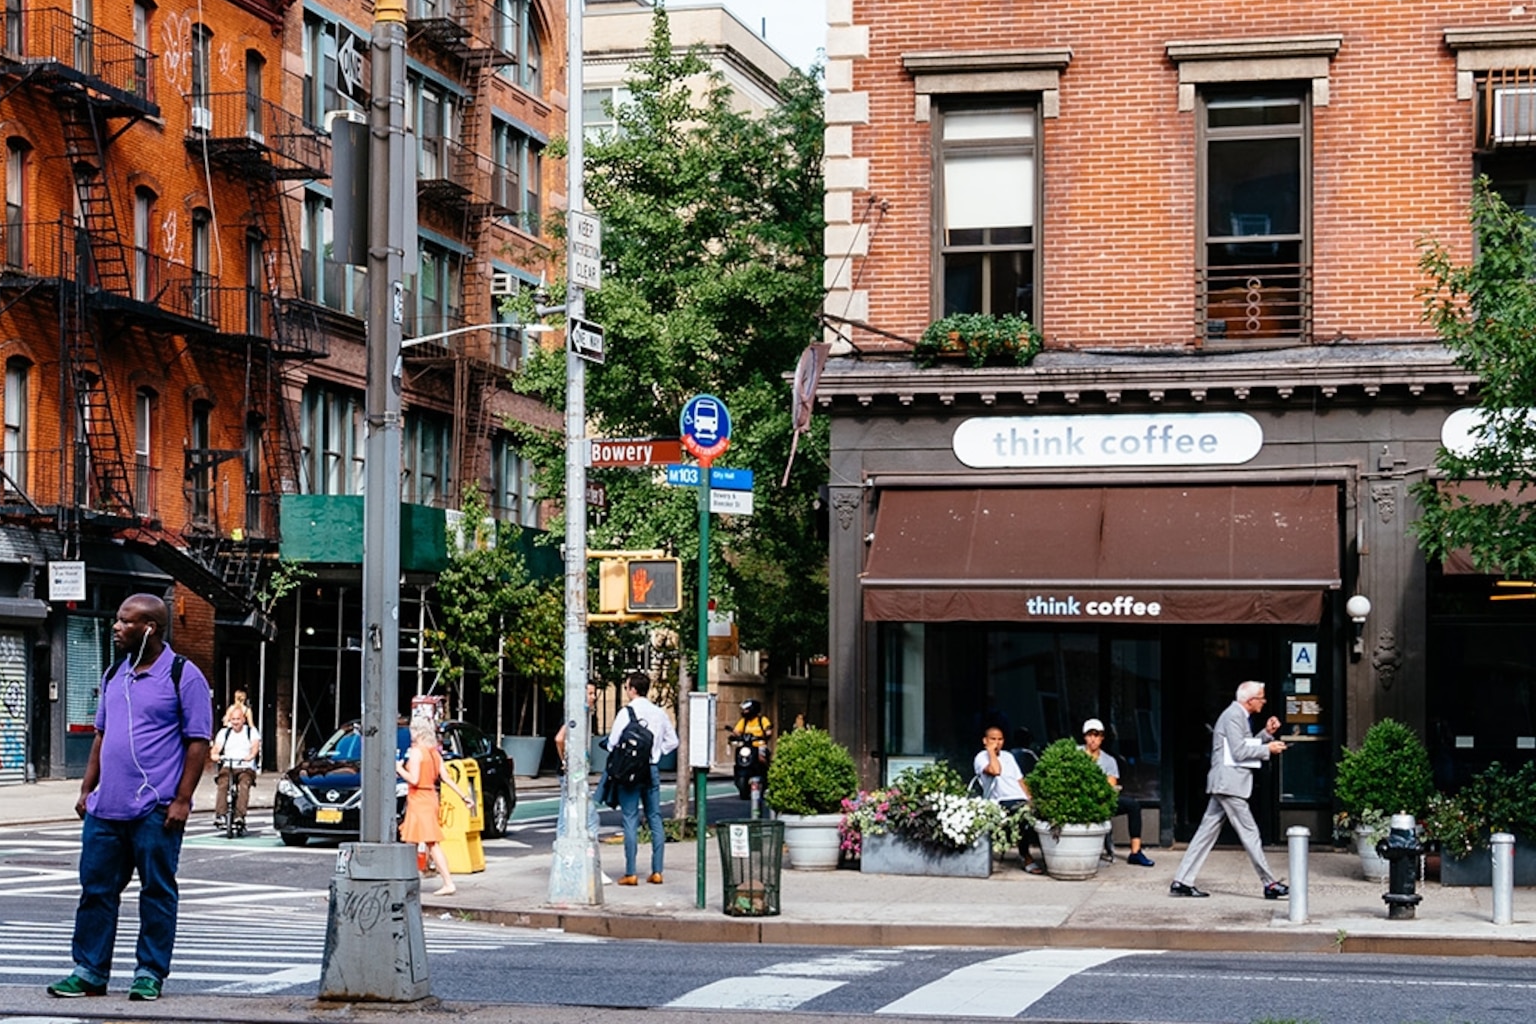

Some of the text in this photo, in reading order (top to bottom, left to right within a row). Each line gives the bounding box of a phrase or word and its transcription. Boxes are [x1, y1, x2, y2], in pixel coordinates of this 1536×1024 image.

[577, 220, 594, 238] KEEP
[576, 261, 597, 280] CLEAR
[993, 424, 1218, 456] think coffee
[591, 444, 653, 465] Bowery
[669, 468, 698, 483] M103
[1026, 596, 1161, 616] think coffee
[1296, 647, 1311, 663] A
